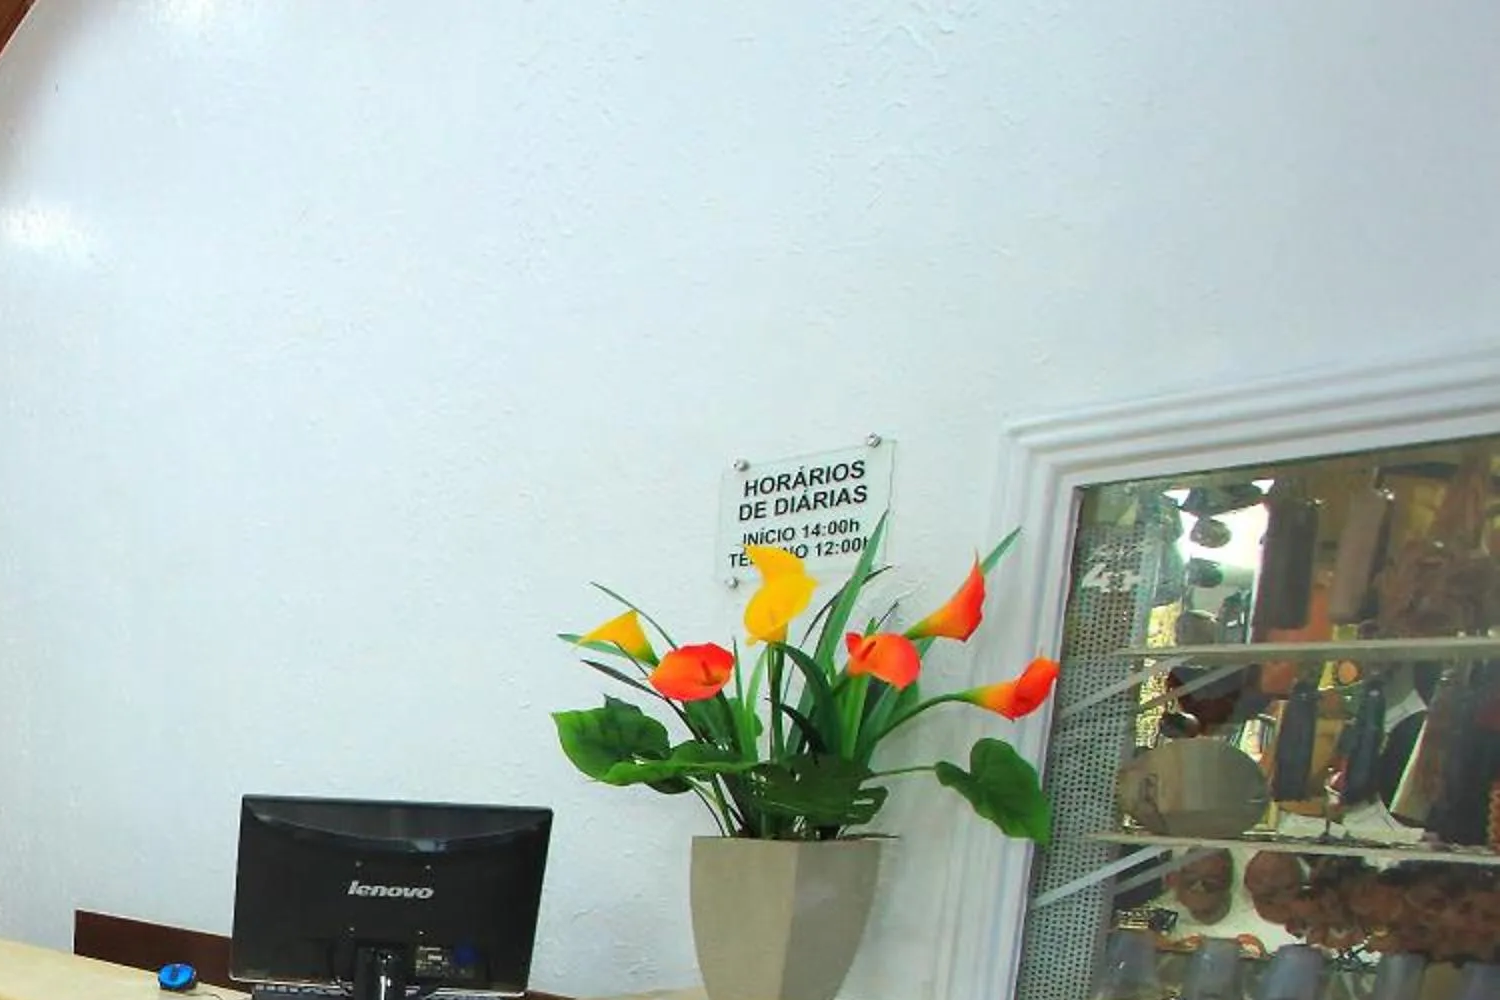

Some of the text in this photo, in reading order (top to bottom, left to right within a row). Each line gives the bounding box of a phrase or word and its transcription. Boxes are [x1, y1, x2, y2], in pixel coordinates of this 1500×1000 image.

[744, 460, 865, 497] HORÁRIOS
[739, 485, 867, 521] DE DIÁRIAS
[743, 519, 860, 546] INÍCIO 14:00h
[348, 880, 435, 899] lenovo
